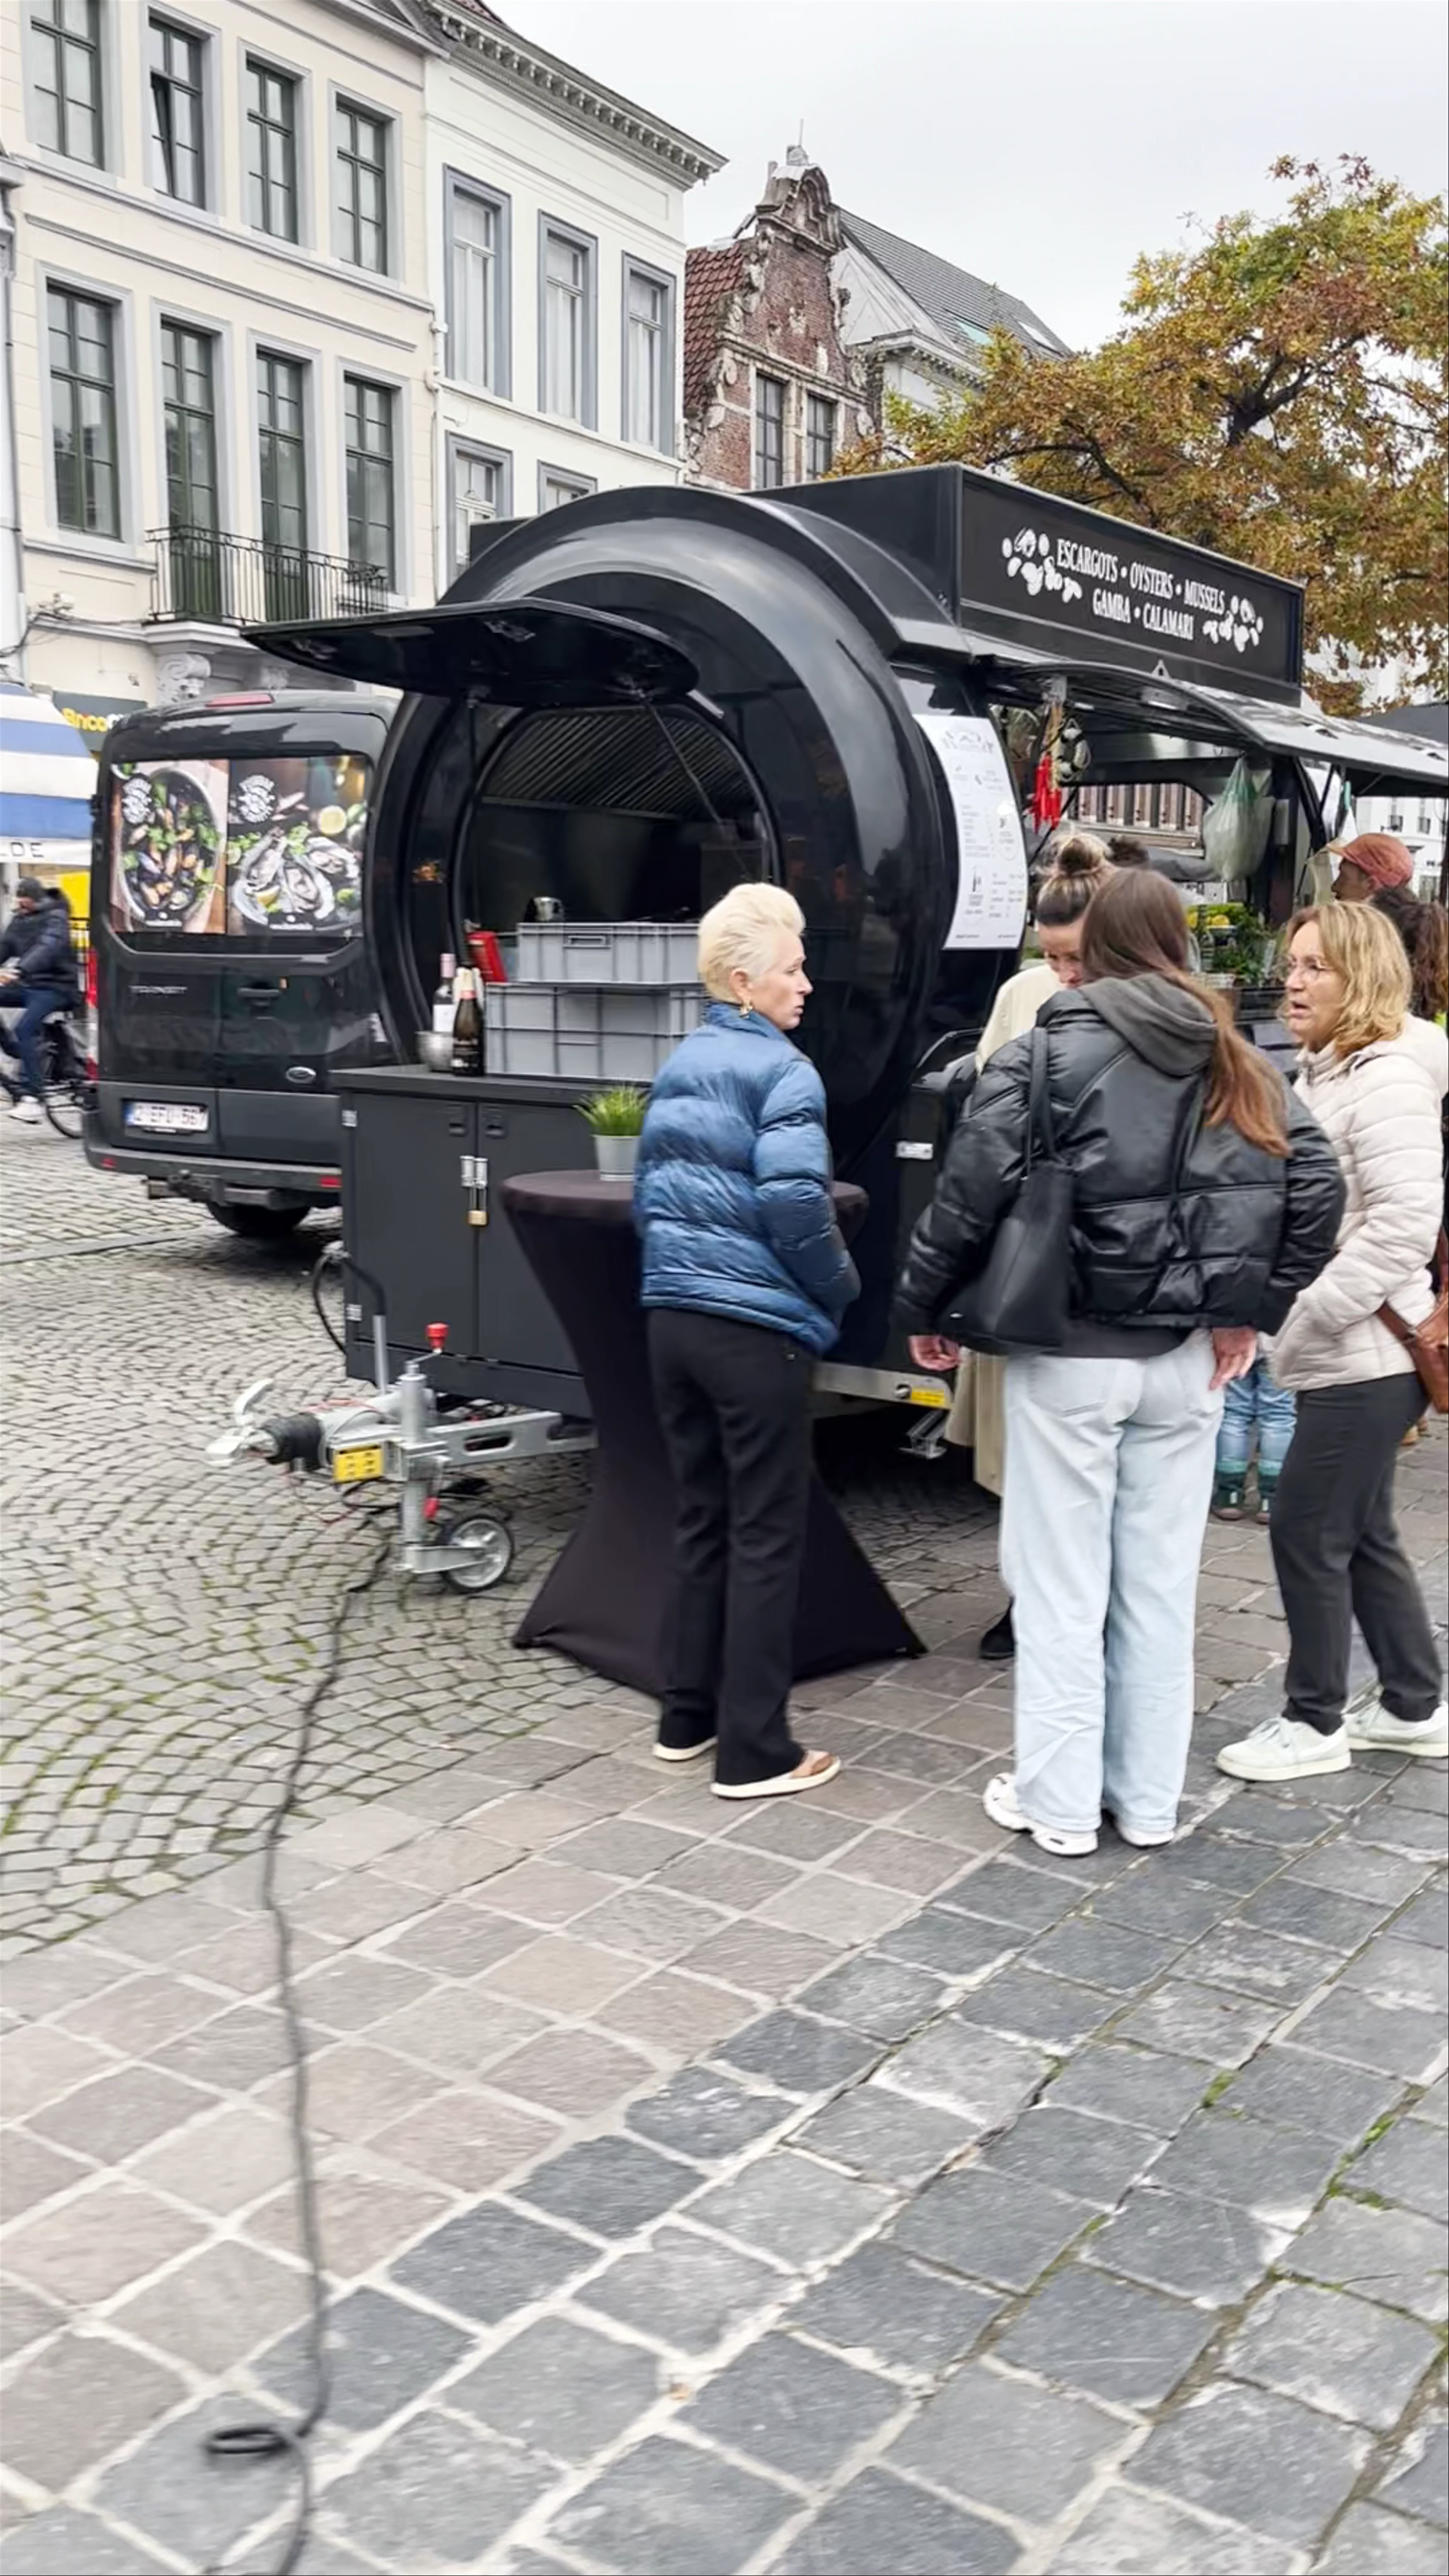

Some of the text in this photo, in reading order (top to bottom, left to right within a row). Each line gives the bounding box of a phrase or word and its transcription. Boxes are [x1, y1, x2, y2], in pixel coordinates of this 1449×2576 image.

[1057, 538, 1225, 615] ESCARGOTS OYSTERS MUSSELS
[1093, 588, 1194, 640] GAMBA CALAMARI
